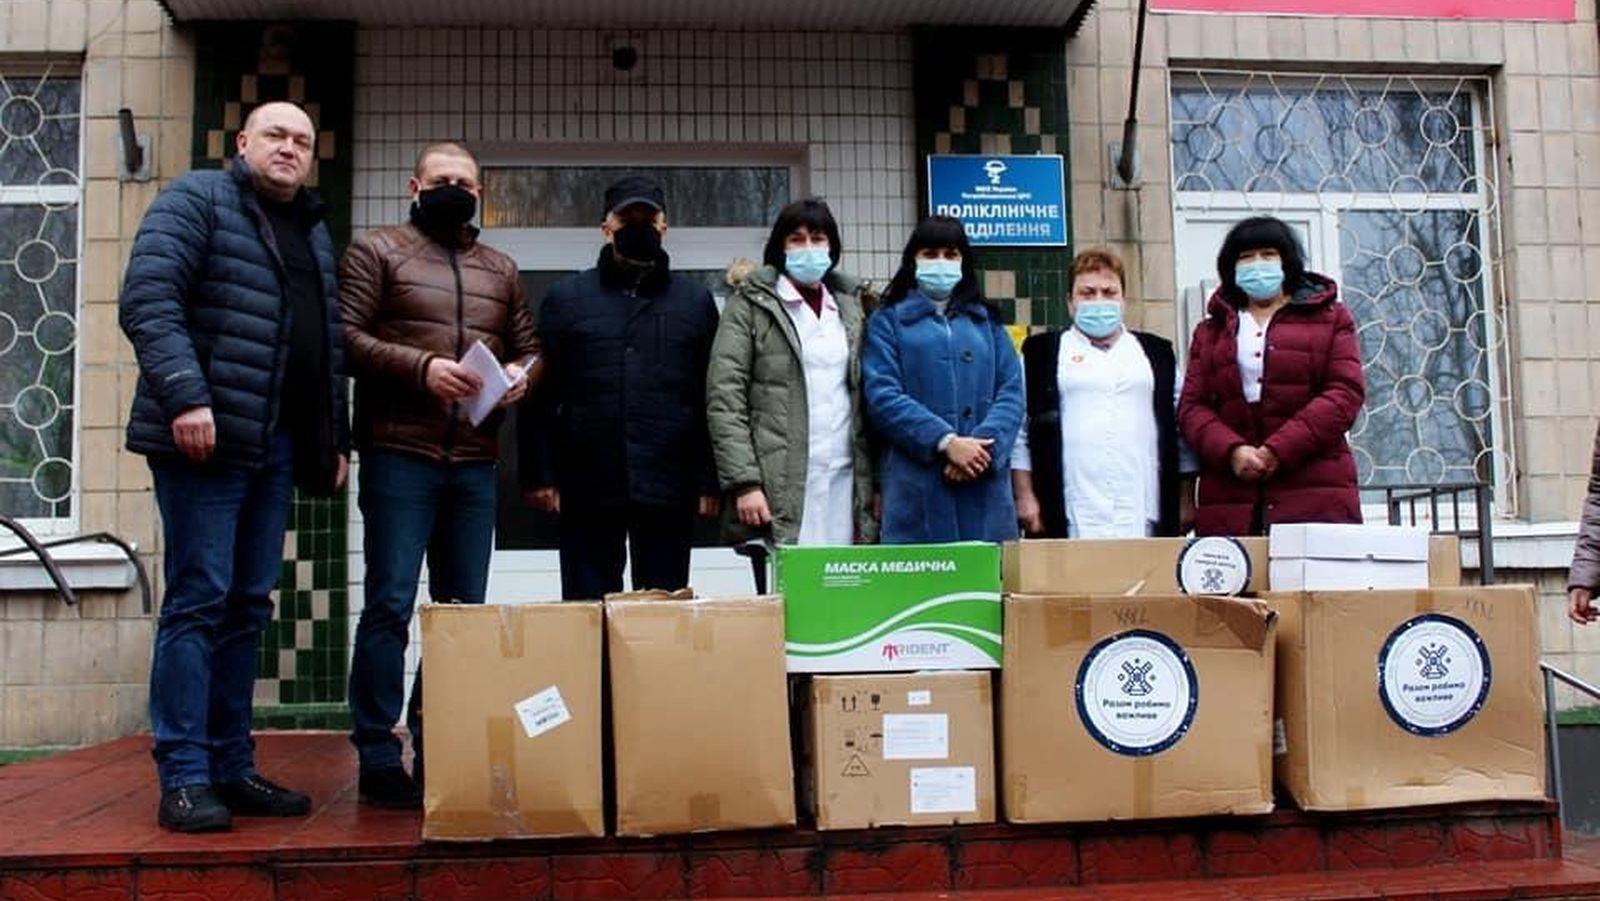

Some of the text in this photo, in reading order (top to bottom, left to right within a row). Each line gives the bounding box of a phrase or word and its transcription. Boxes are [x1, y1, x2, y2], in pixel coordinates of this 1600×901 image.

[937, 204, 1060, 218] ПОЛІКЛІНІЧНЕ
[964, 223, 1051, 239] ДДІЛЕННЯ
[825, 560, 957, 574] МАСКА МЕДИЧНА
